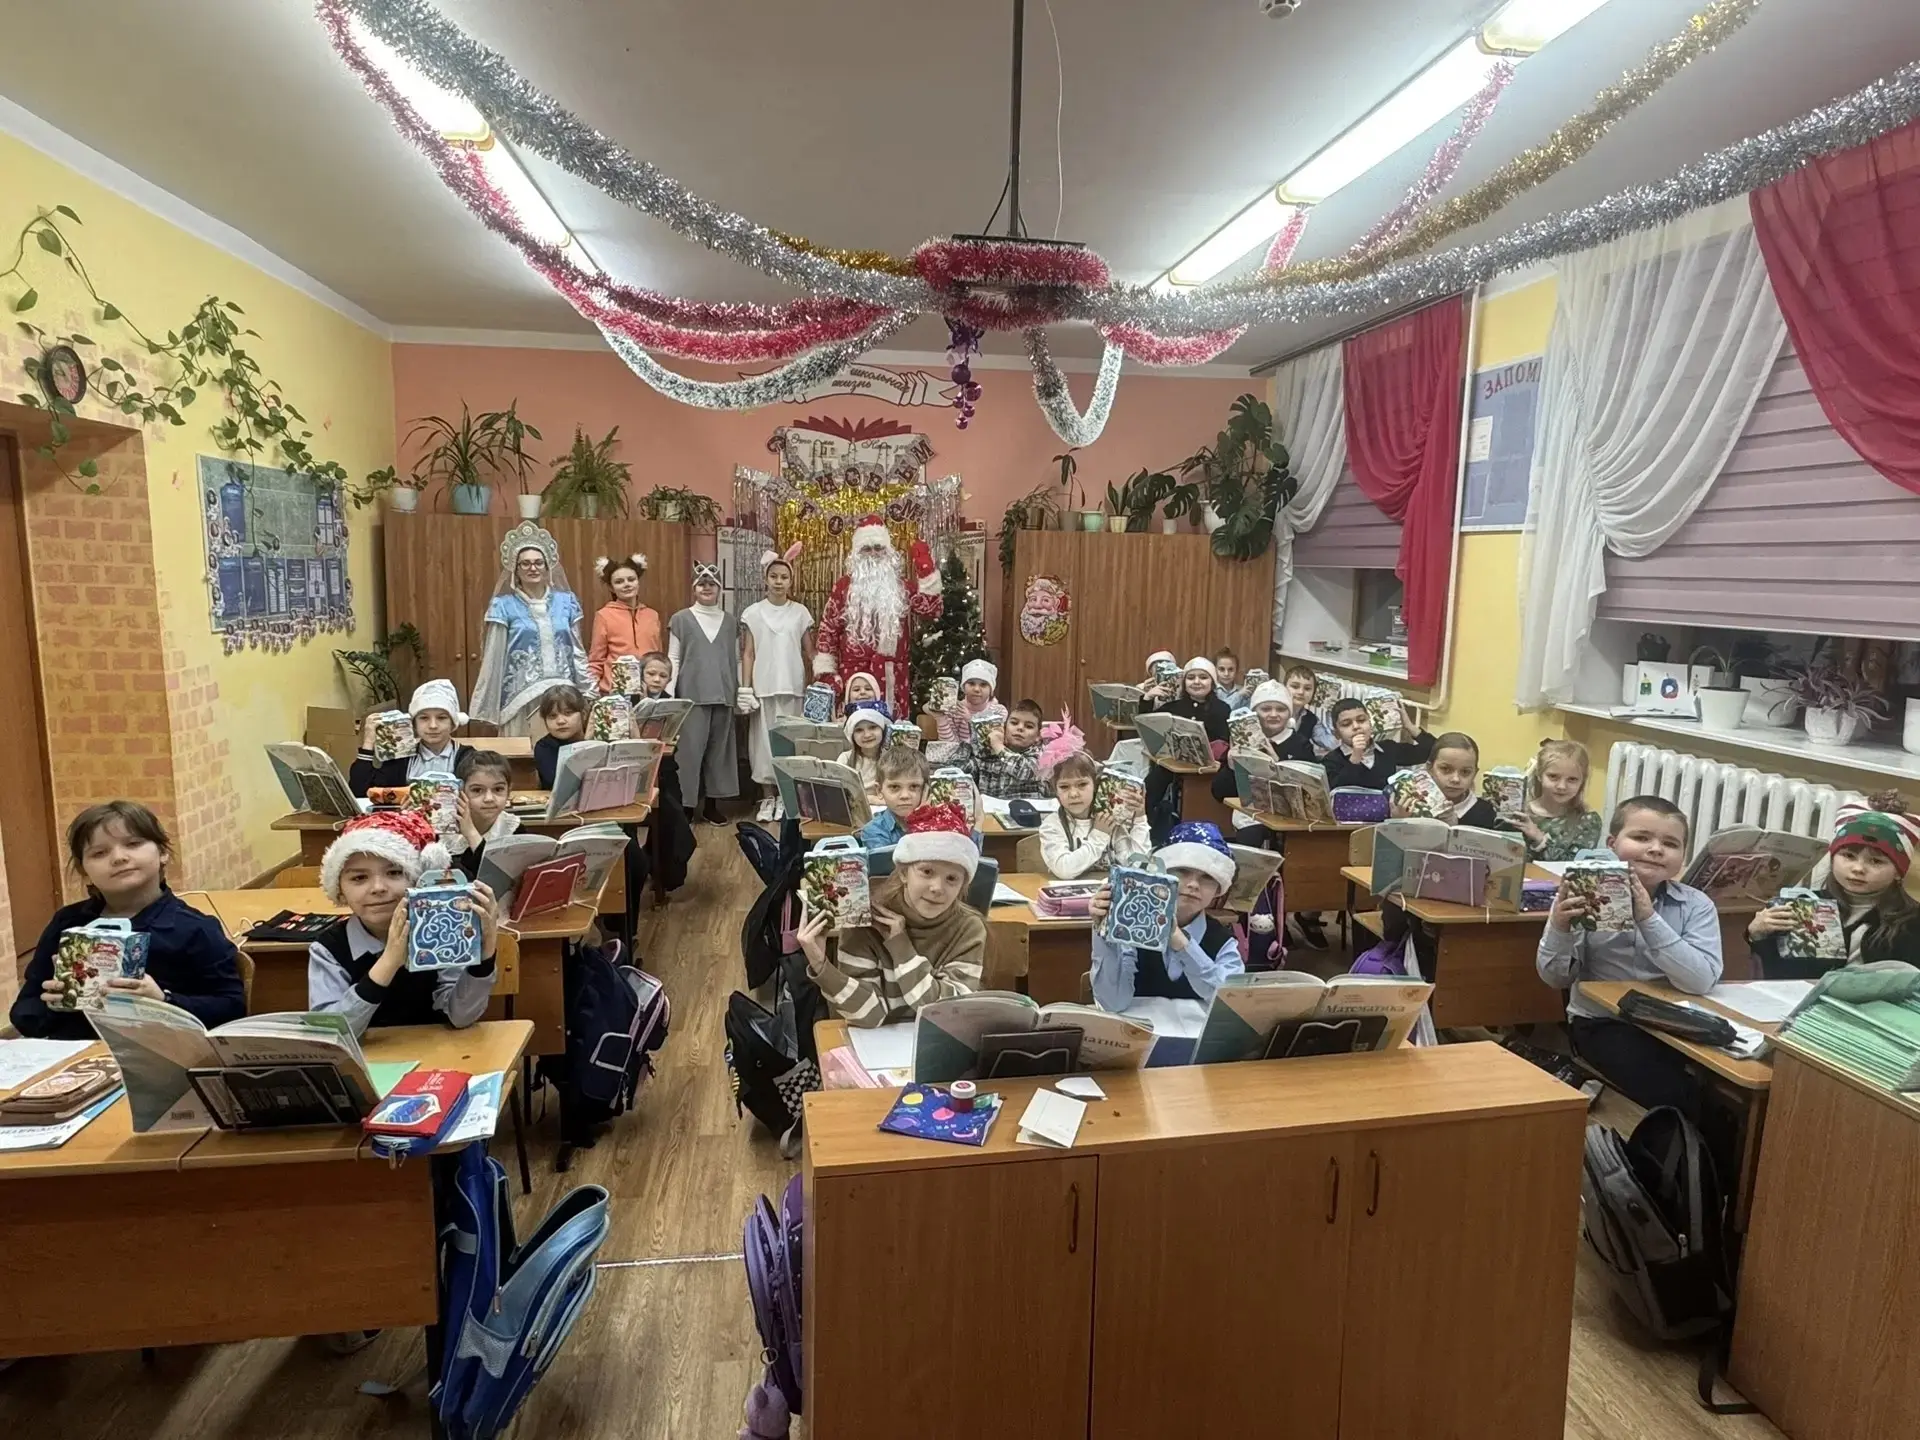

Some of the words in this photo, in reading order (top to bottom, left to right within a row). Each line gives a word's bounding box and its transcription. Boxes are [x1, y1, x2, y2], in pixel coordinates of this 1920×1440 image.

[1454, 843, 1515, 863] Математика
[1325, 1003, 1406, 1014] Математика
[1083, 1036, 1131, 1050] атика
[232, 1052, 338, 1062] Математика
